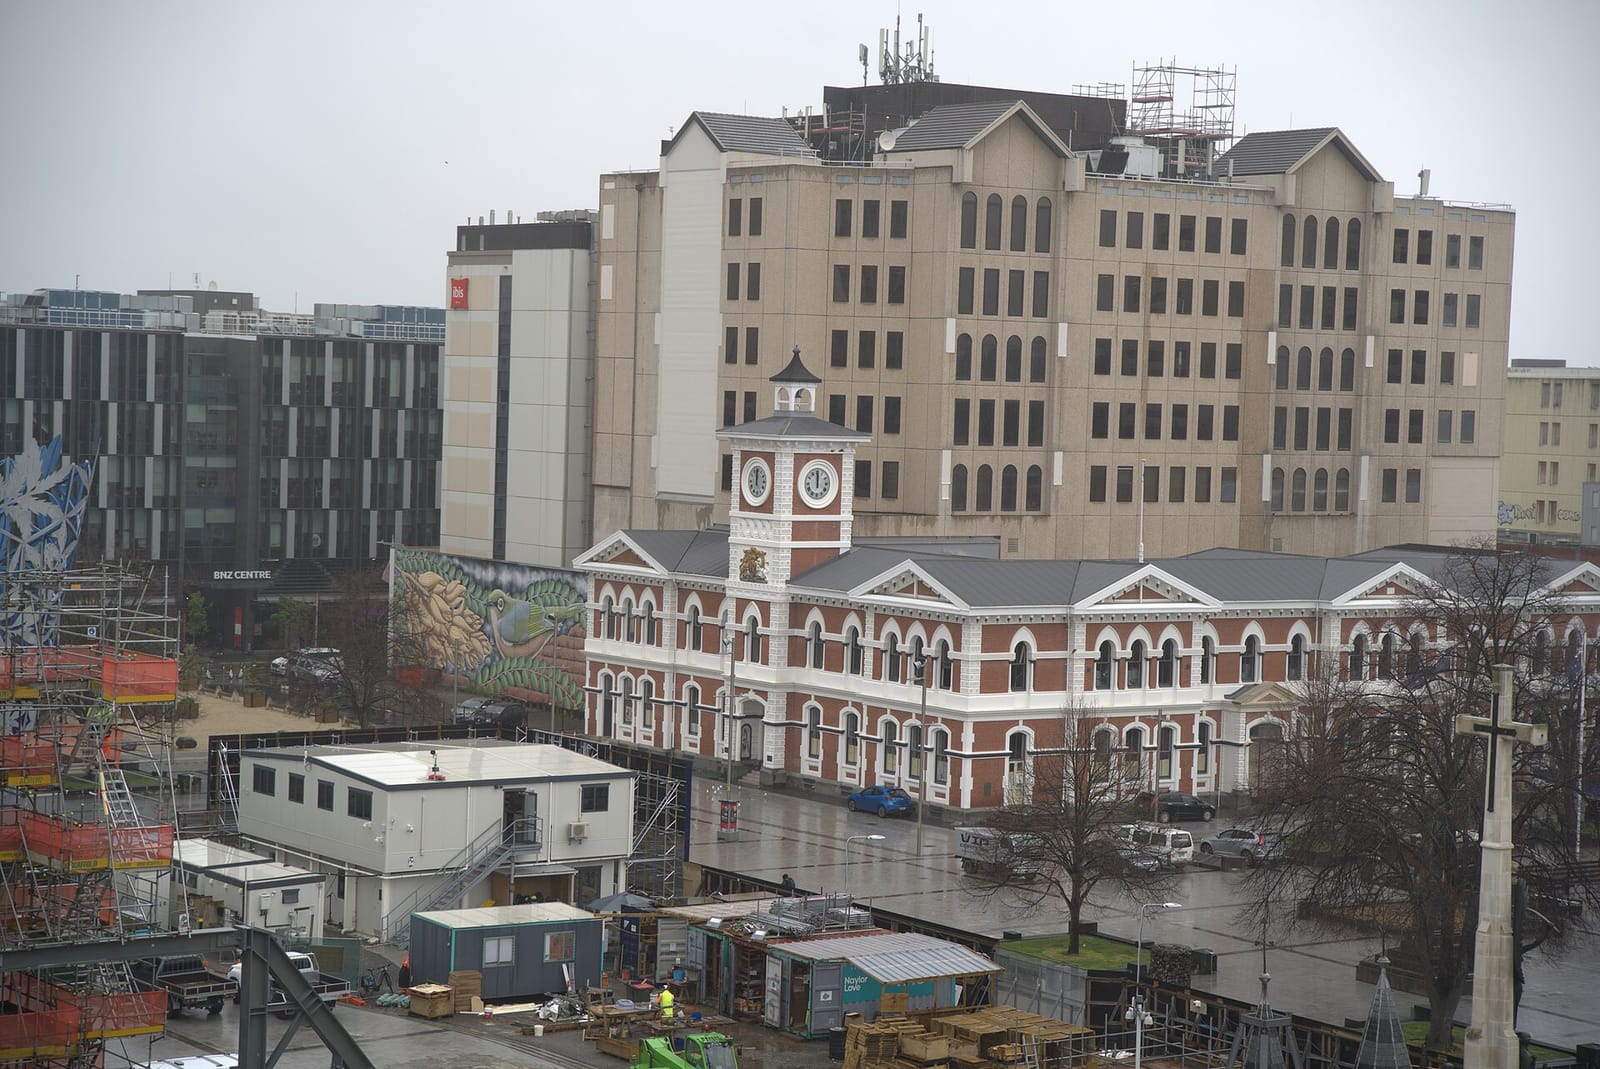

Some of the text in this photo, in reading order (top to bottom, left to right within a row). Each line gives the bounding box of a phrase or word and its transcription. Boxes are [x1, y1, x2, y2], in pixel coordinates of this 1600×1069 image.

[452, 286, 464, 298] ibis
[213, 570, 272, 580] BNZ CENTRE
[844, 976, 869, 985] Naylor
[844, 984, 861, 992] Love
